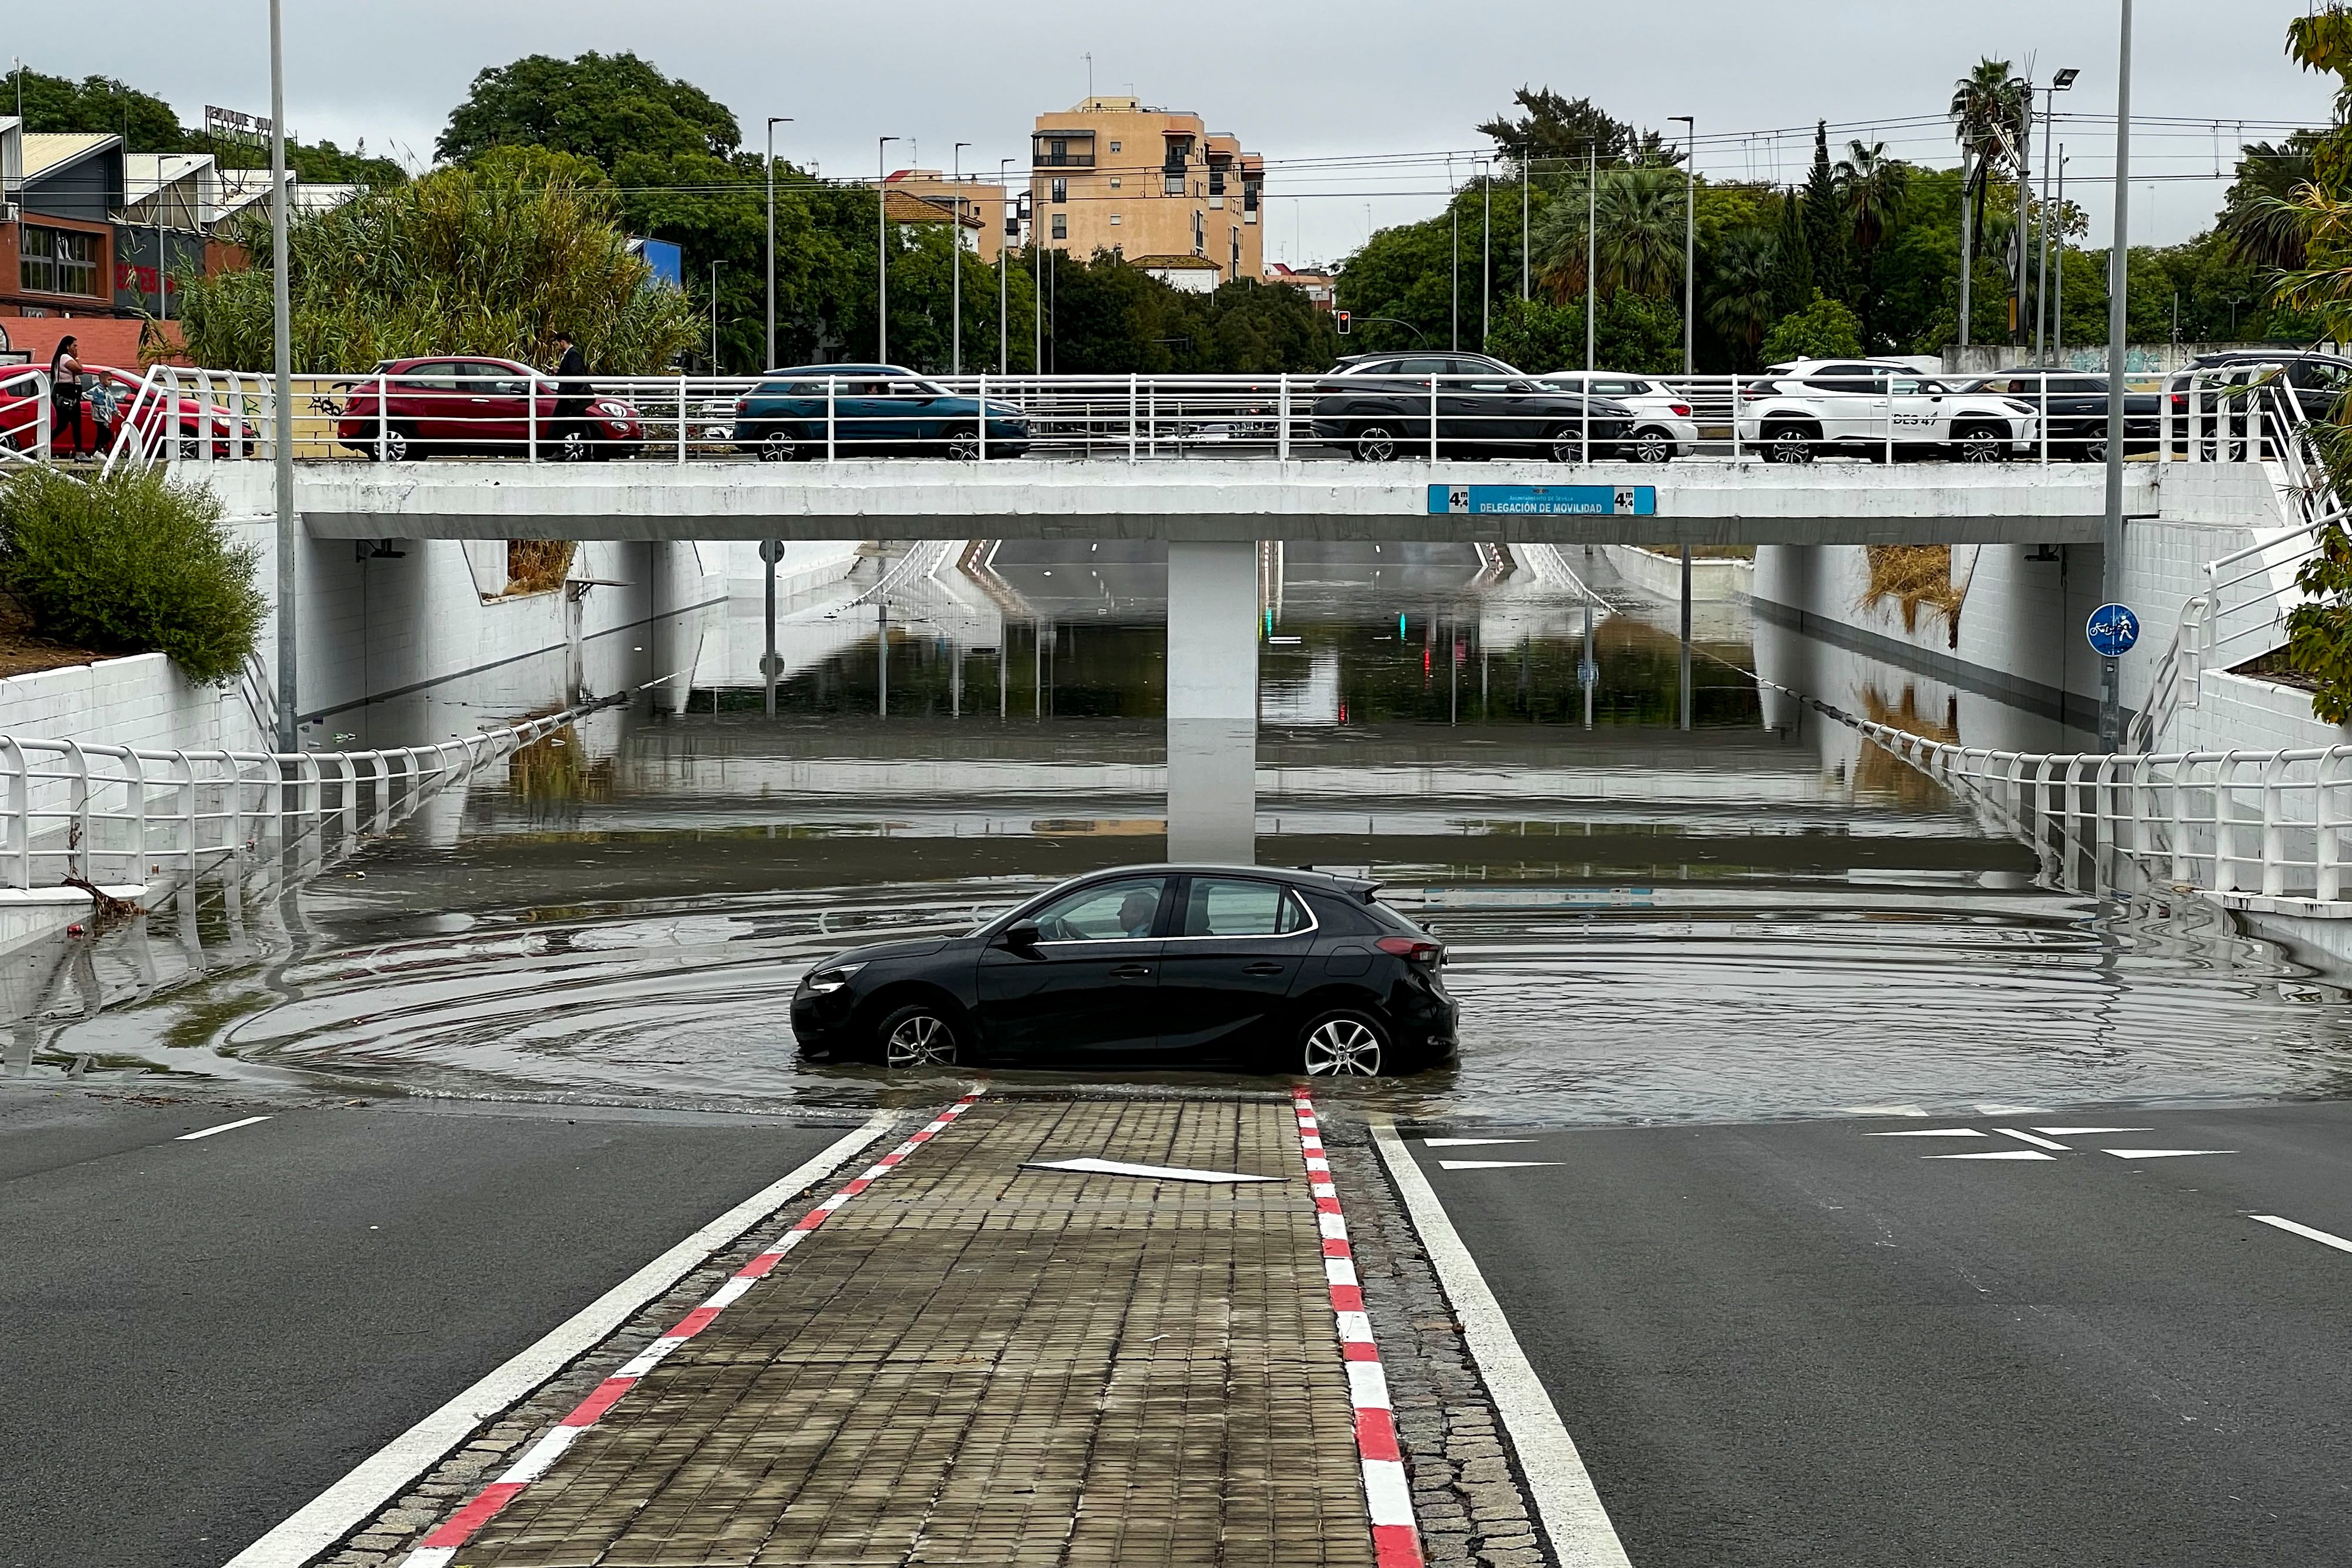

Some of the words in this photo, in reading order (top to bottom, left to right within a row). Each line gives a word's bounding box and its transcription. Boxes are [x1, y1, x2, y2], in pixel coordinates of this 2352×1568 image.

[1891, 414, 1919, 425] DES
[1480, 501, 1537, 513] DELEGACIÓN
[1539, 503, 1552, 513] DE
[1553, 503, 1602, 513] MOVILIDAD
